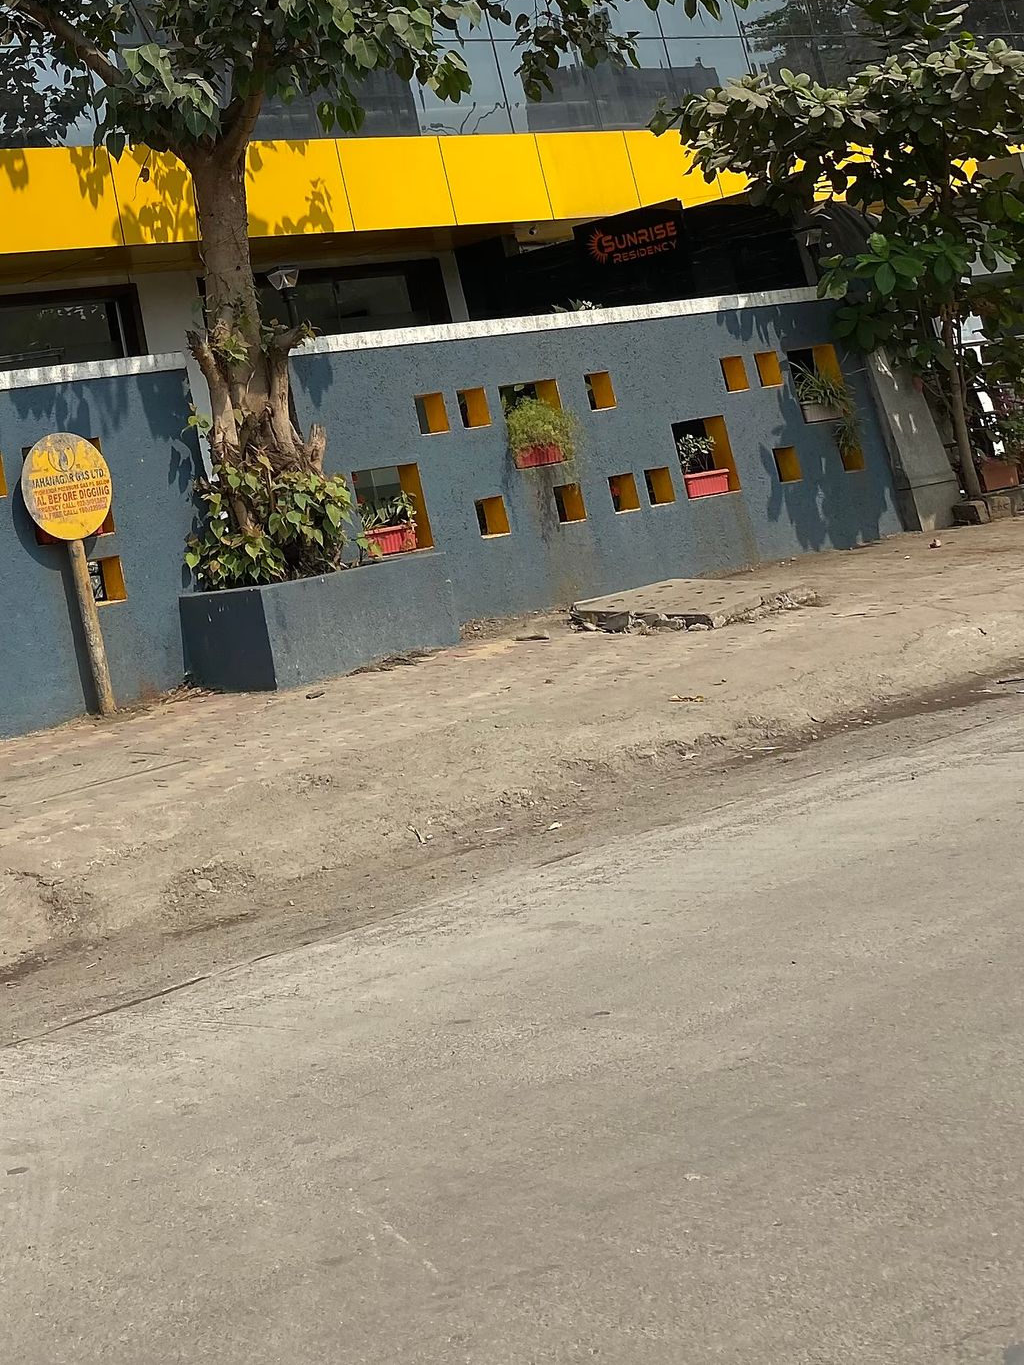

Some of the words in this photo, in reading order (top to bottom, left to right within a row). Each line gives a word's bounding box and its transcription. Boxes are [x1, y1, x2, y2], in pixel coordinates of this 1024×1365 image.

[601, 220, 678, 253] SUNRISE
[612, 240, 678, 264] RESIDENCY
[75, 470, 90, 482] GAS
[48, 490, 78, 505] BEFORE
[79, 485, 110, 500] DIGGING
